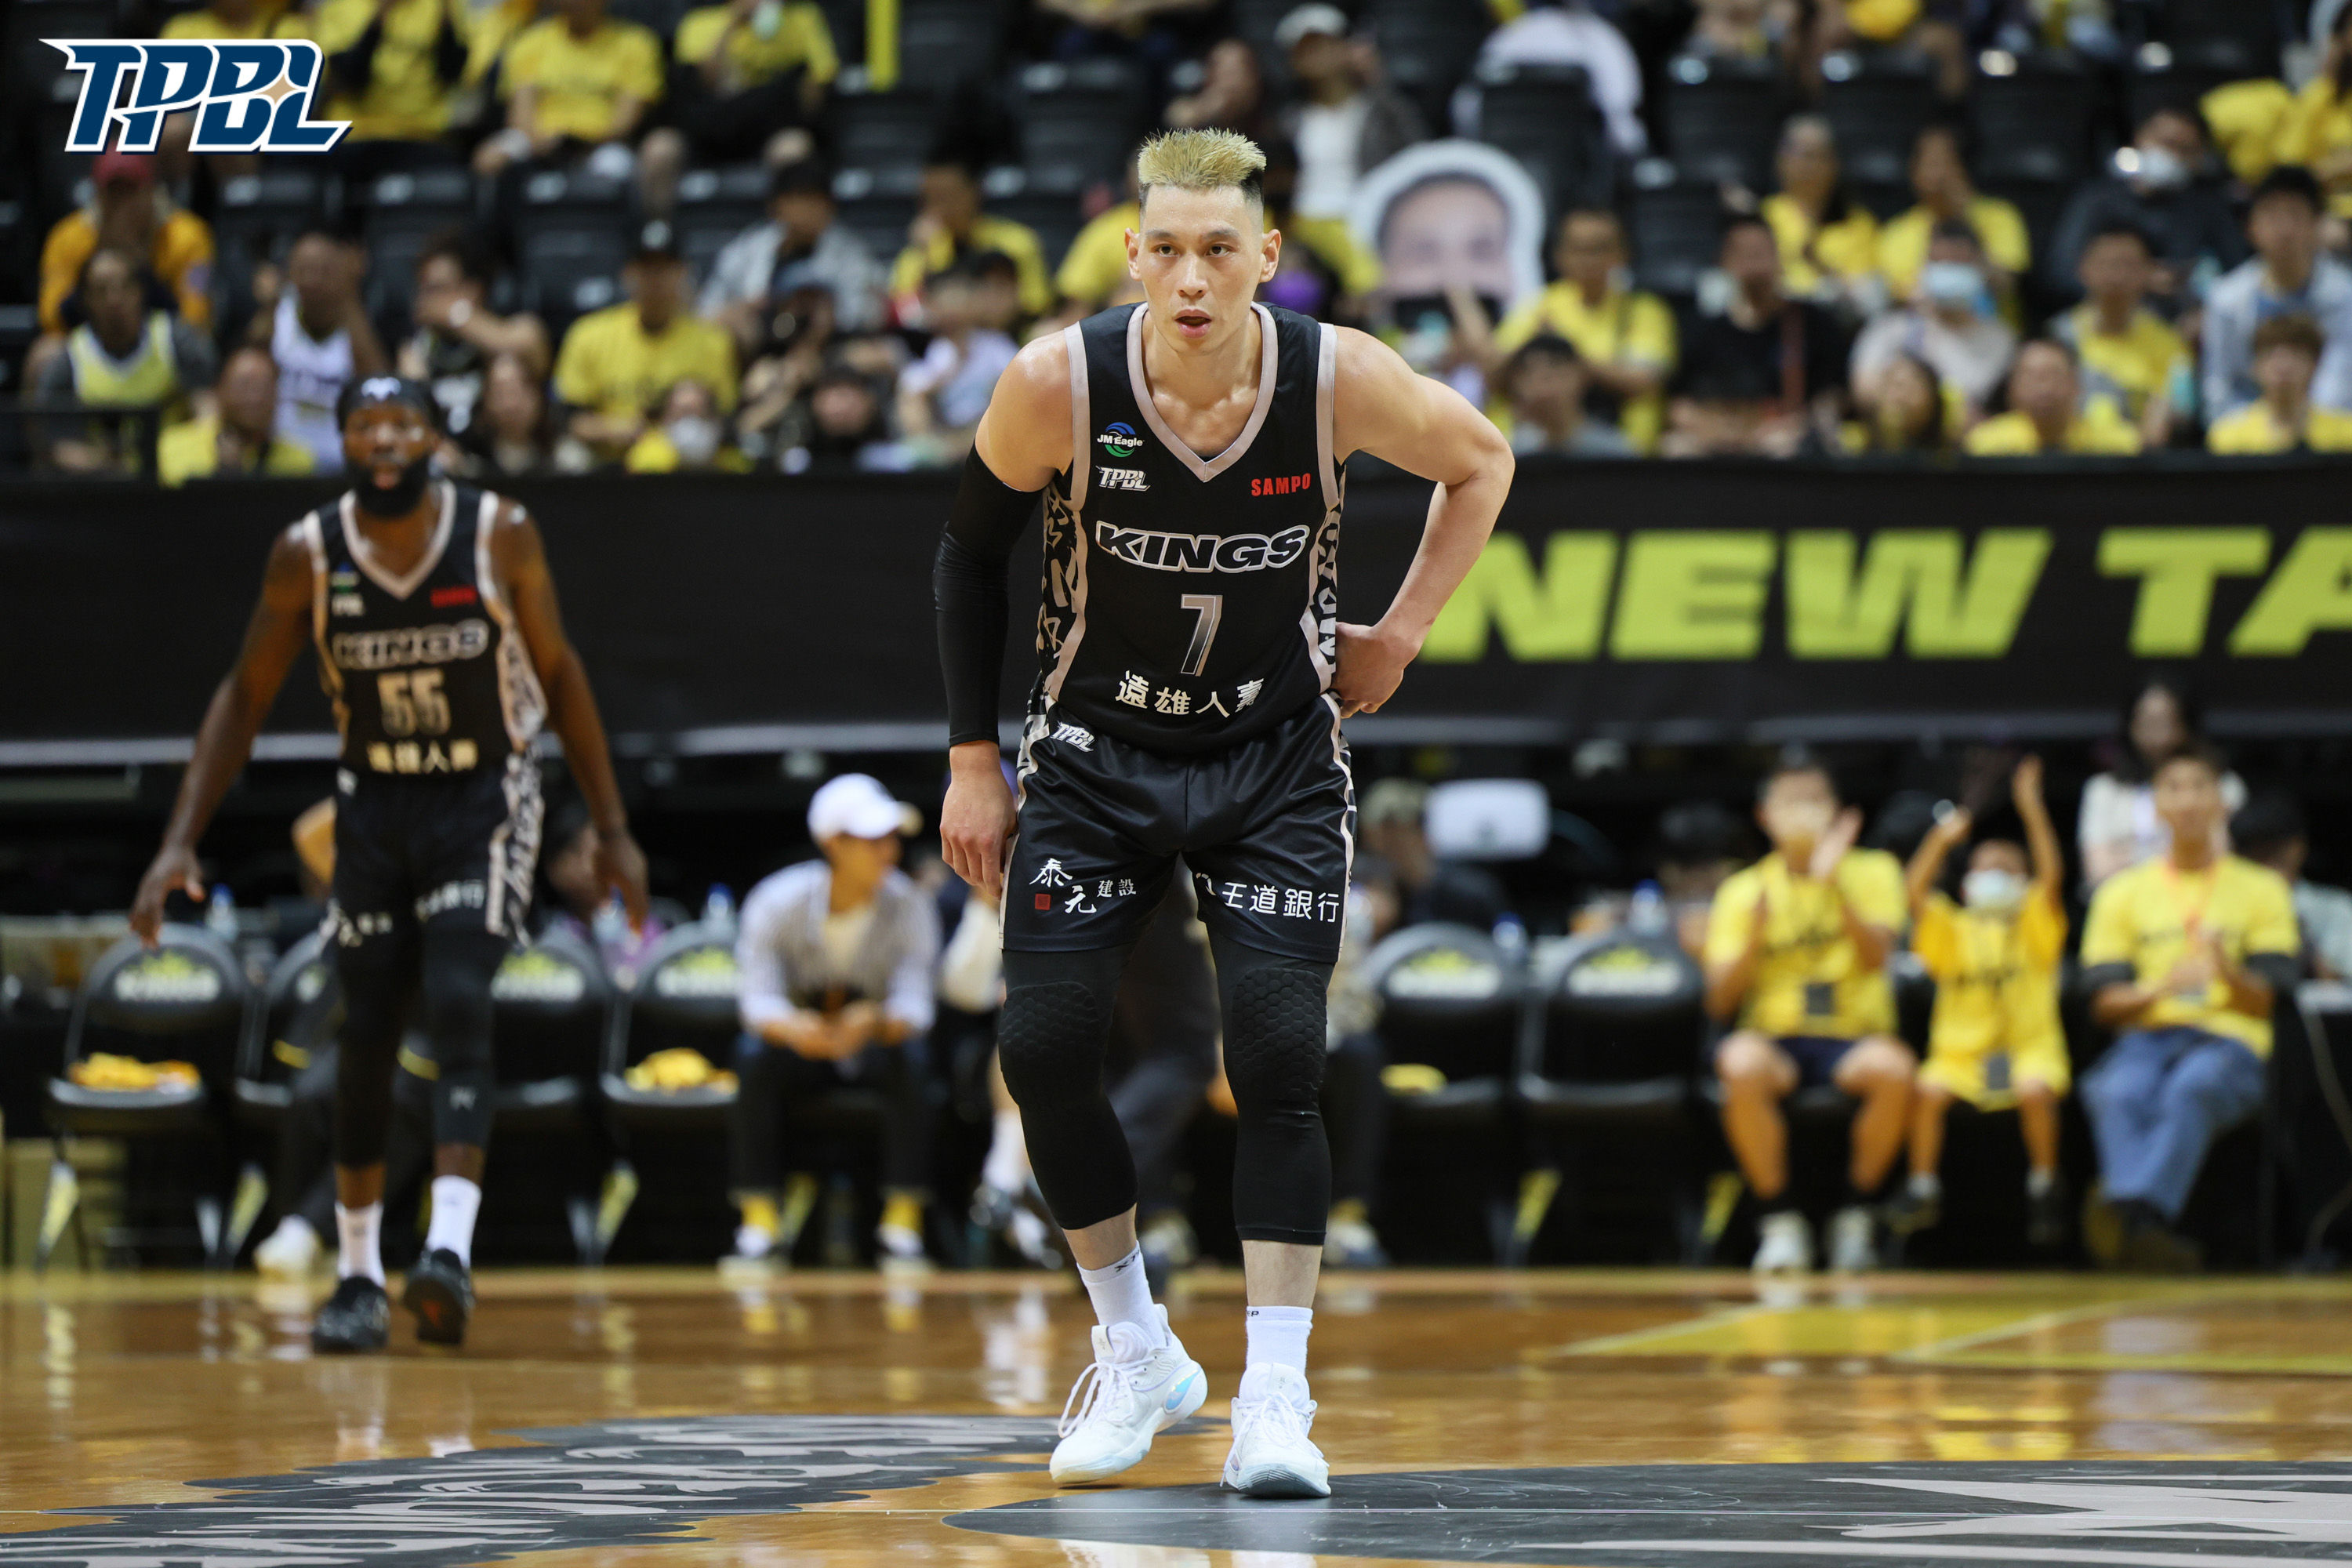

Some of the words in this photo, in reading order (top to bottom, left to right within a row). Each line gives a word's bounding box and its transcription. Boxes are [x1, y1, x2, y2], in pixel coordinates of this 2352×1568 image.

[1098, 434, 1112, 444] JM
[1114, 436, 1143, 447] Eagle
[1095, 466, 1151, 492] TPBL
[1250, 473, 1311, 496] SAMPO
[1095, 521, 1310, 573] KINGS
[1419, 529, 2054, 661] NEW
[1180, 593, 1223, 677] 7
[377, 668, 452, 737] 55
[1050, 720, 1095, 752] TPBL
[1222, 882, 1339, 922] 王道銀行
